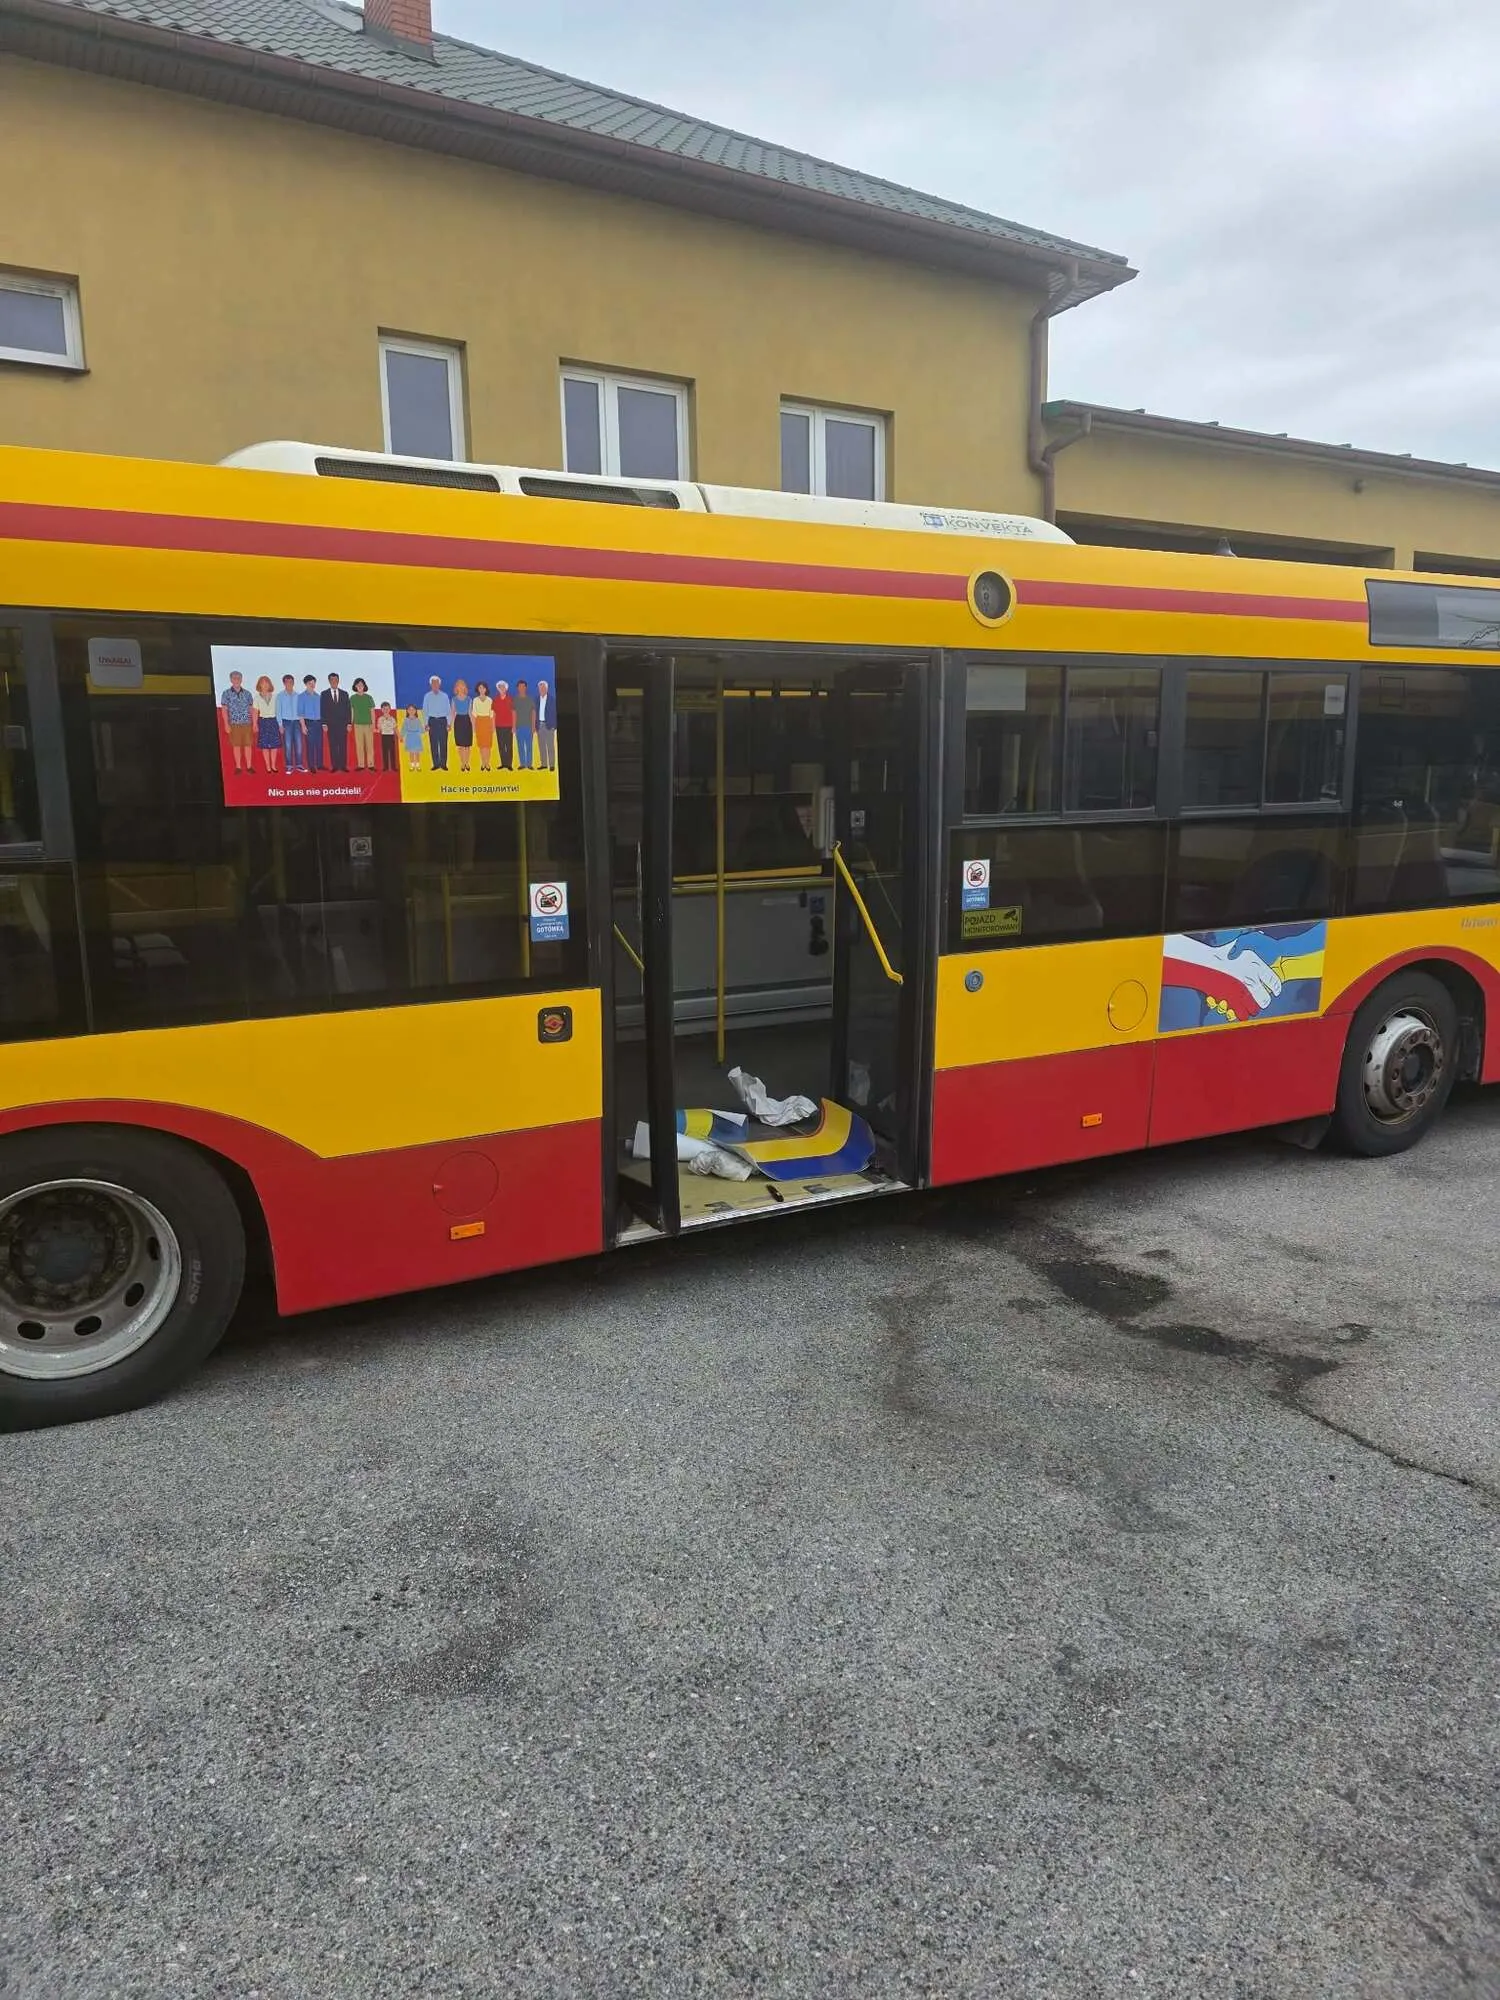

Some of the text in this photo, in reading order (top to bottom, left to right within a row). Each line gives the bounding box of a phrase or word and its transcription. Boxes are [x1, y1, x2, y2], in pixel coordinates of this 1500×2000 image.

[945, 516, 1033, 534] KONVEKTA
[268, 788, 285, 797] Nic
[306, 788, 321, 796] nie
[322, 786, 362, 798] podzieli!
[440, 785, 458, 793] Нас
[472, 784, 520, 795] розділити!
[965, 914, 996, 925] POJAZD
